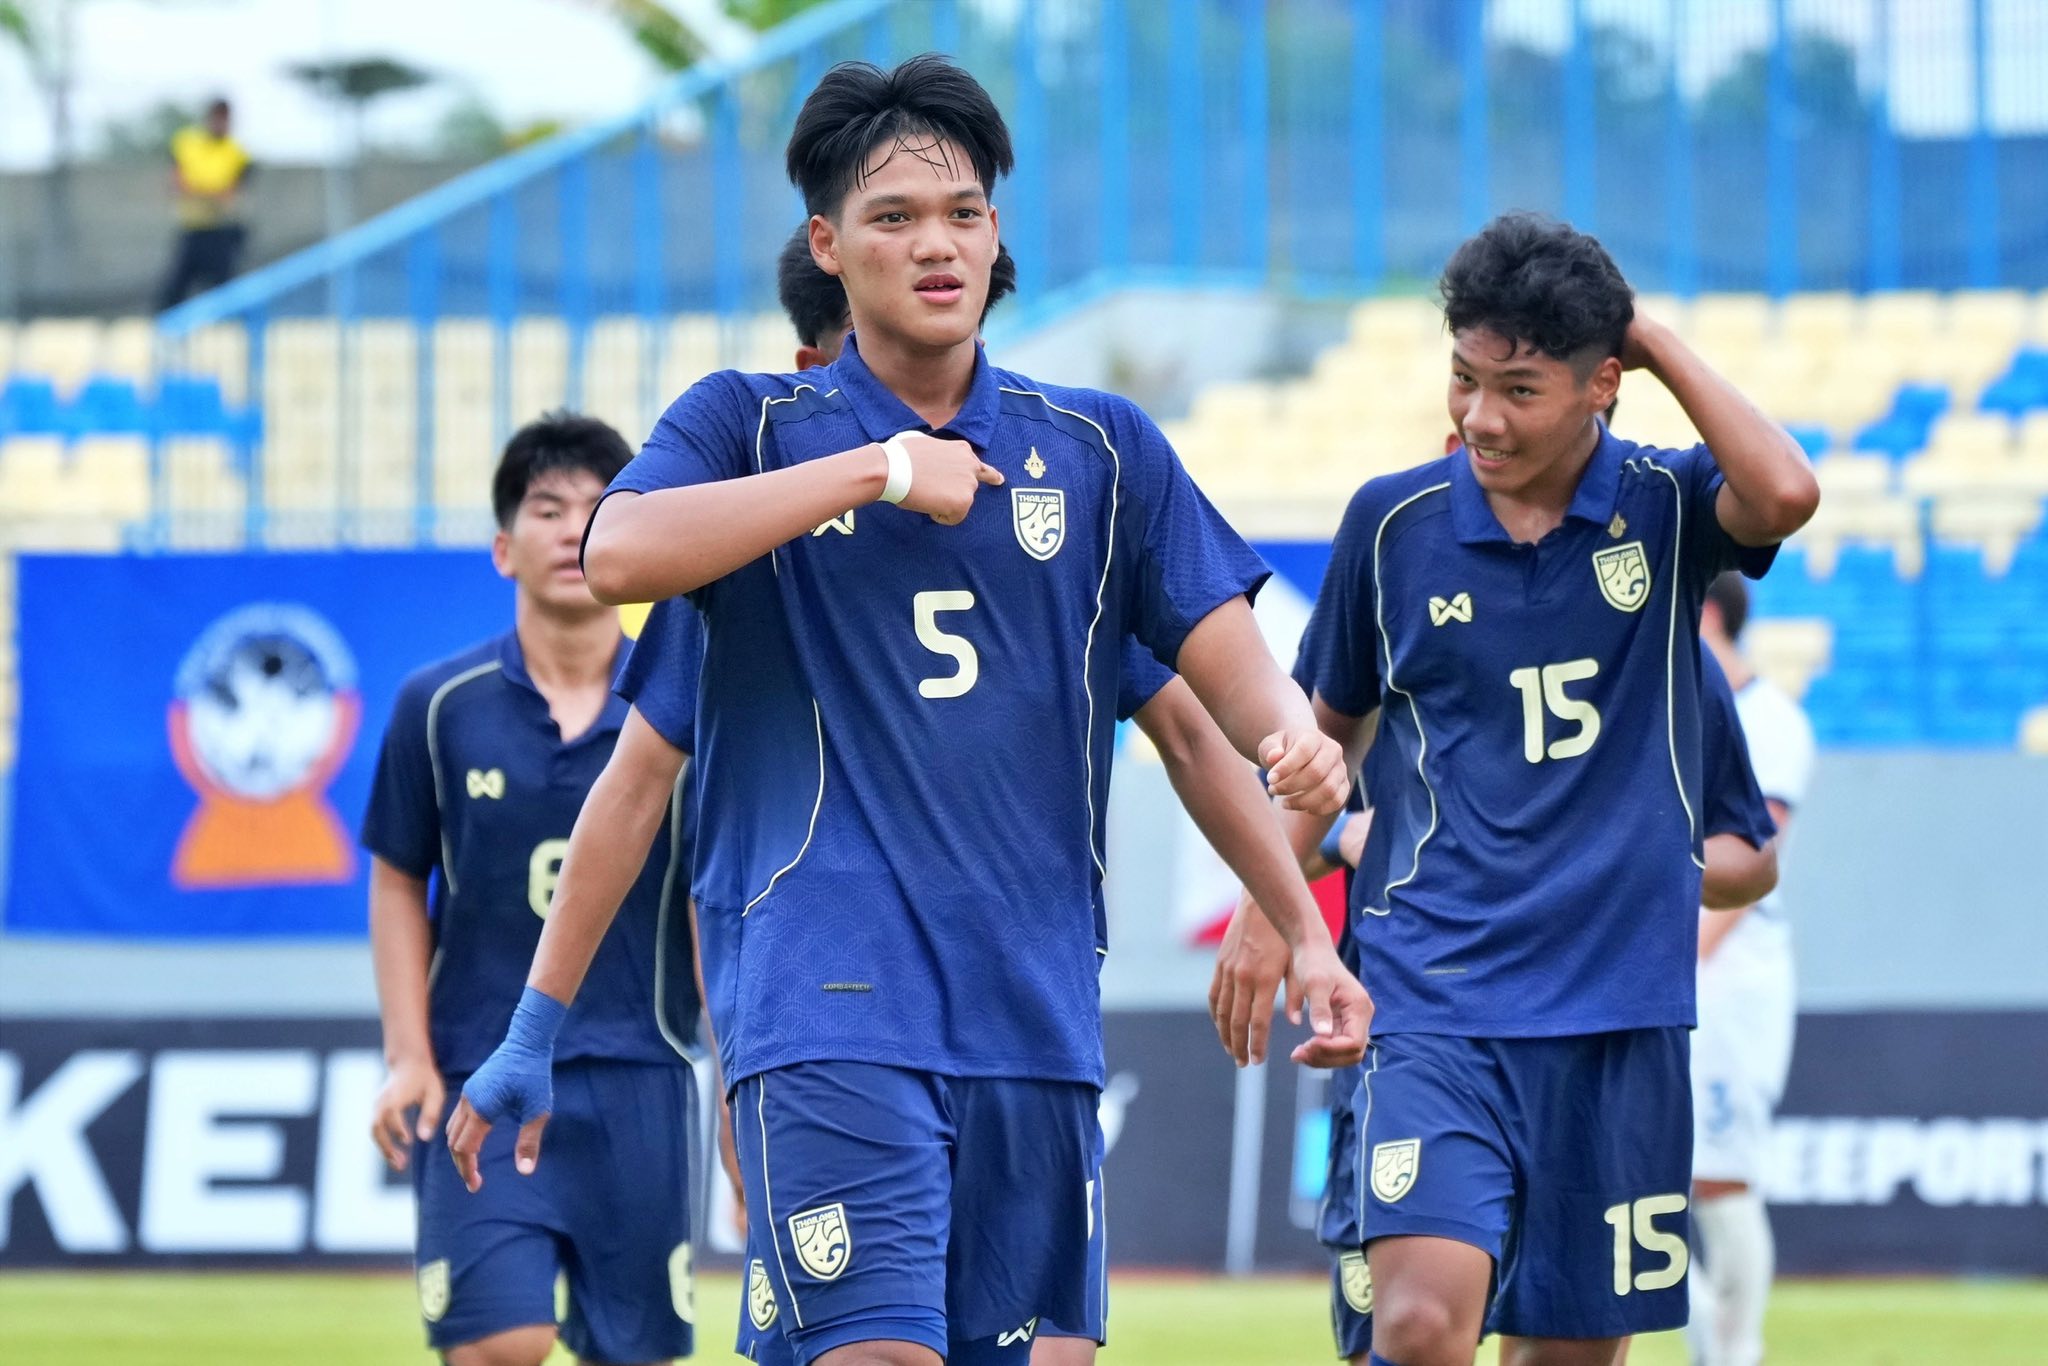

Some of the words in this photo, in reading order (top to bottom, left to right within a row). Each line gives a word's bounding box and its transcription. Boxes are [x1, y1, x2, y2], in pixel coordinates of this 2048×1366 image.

[1017, 494, 1060, 503] THAILAND
[913, 590, 979, 699] 5
[1509, 658, 1601, 764] 15
[795, 1211, 838, 1230] THAILAND
[1604, 1194, 1689, 1296] 15
